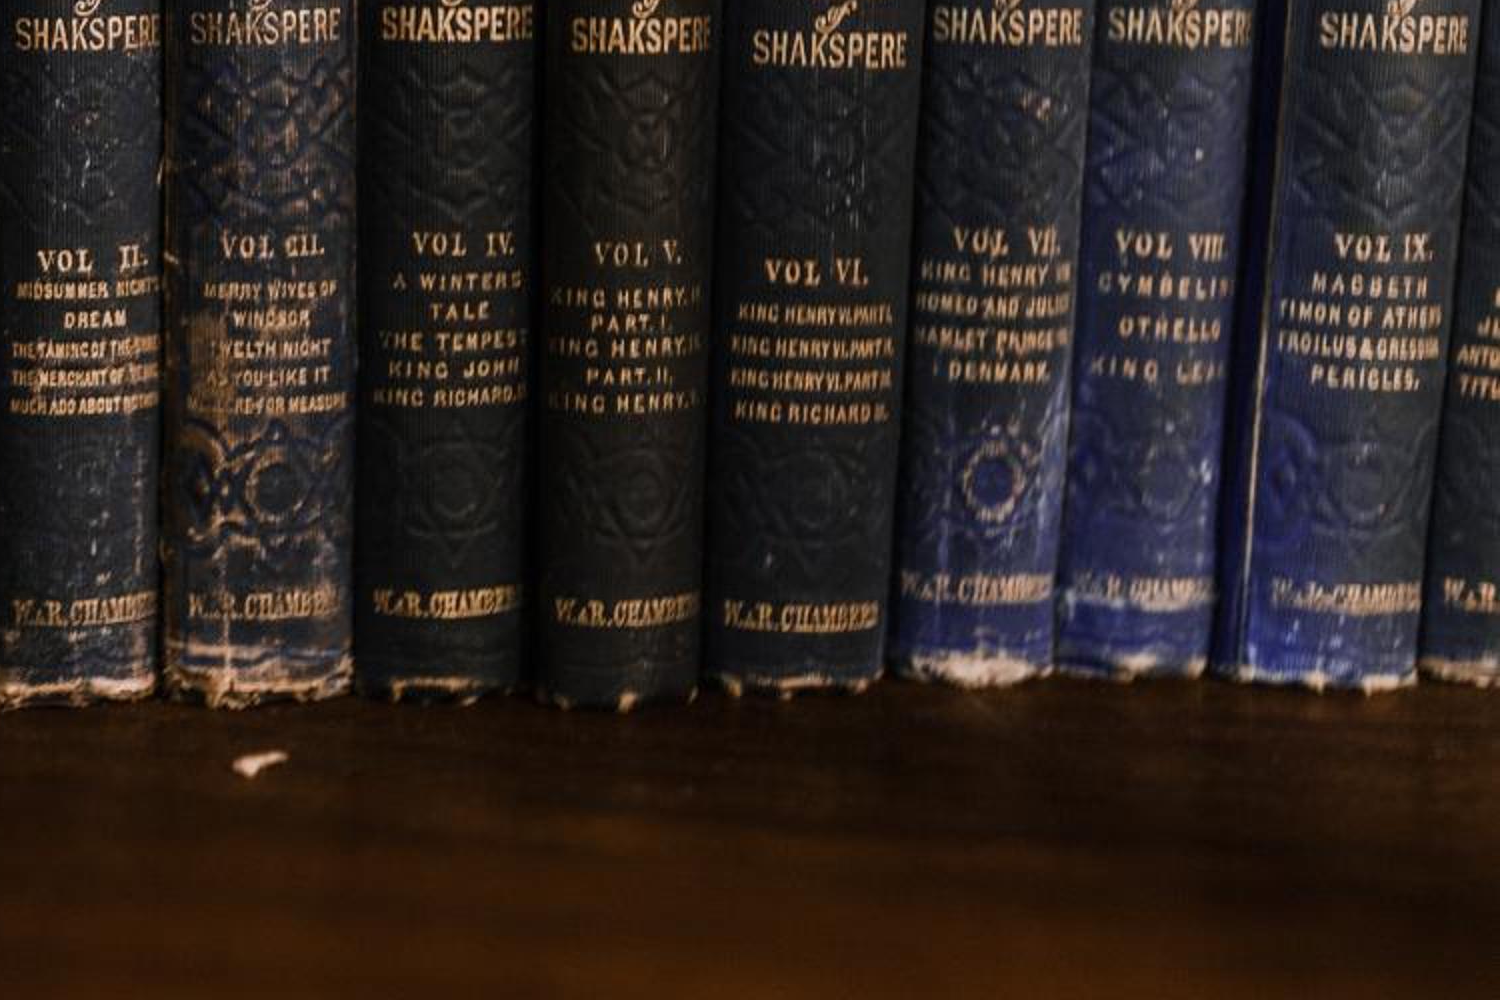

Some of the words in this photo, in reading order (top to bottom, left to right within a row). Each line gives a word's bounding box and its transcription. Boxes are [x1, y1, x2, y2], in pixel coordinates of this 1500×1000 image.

[191, 7, 341, 46] SHAKSPERE
[382, 4, 533, 42] SHAKSPERE
[815, 0, 857, 34] of
[932, 7, 1083, 47] SHAKSPERE
[1108, 8, 1252, 50] SHAKSPERE
[15, 13, 162, 53] SHAKSPERE
[571, 15, 710, 55] SHAKSPERE
[1320, 13, 1469, 56] SHAKSPERE
[752, 30, 907, 70] SHAKSPERE
[921, 262, 971, 283] KING
[982, 263, 1049, 288] HENRY
[1312, 271, 1428, 299] MACBETH
[15, 280, 109, 299] MIDSUMMER
[64, 308, 127, 329] DREAM
[430, 300, 490, 320] TALE
[738, 303, 779, 324] KING
[983, 296, 1020, 319] AND
[1348, 304, 1373, 327] OF
[1118, 314, 1221, 342] OTHELLO
[284, 337, 332, 357] NIGHT
[315, 365, 331, 384] IT
[389, 360, 449, 379] KING
[463, 357, 519, 378] JOHN
[1091, 355, 1159, 384] KING
[9, 396, 47, 415] MUCH
[51, 398, 77, 415] ADO
[78, 395, 122, 414] ABOUT
[734, 401, 782, 423] KING
[787, 402, 871, 424] RICHARD
